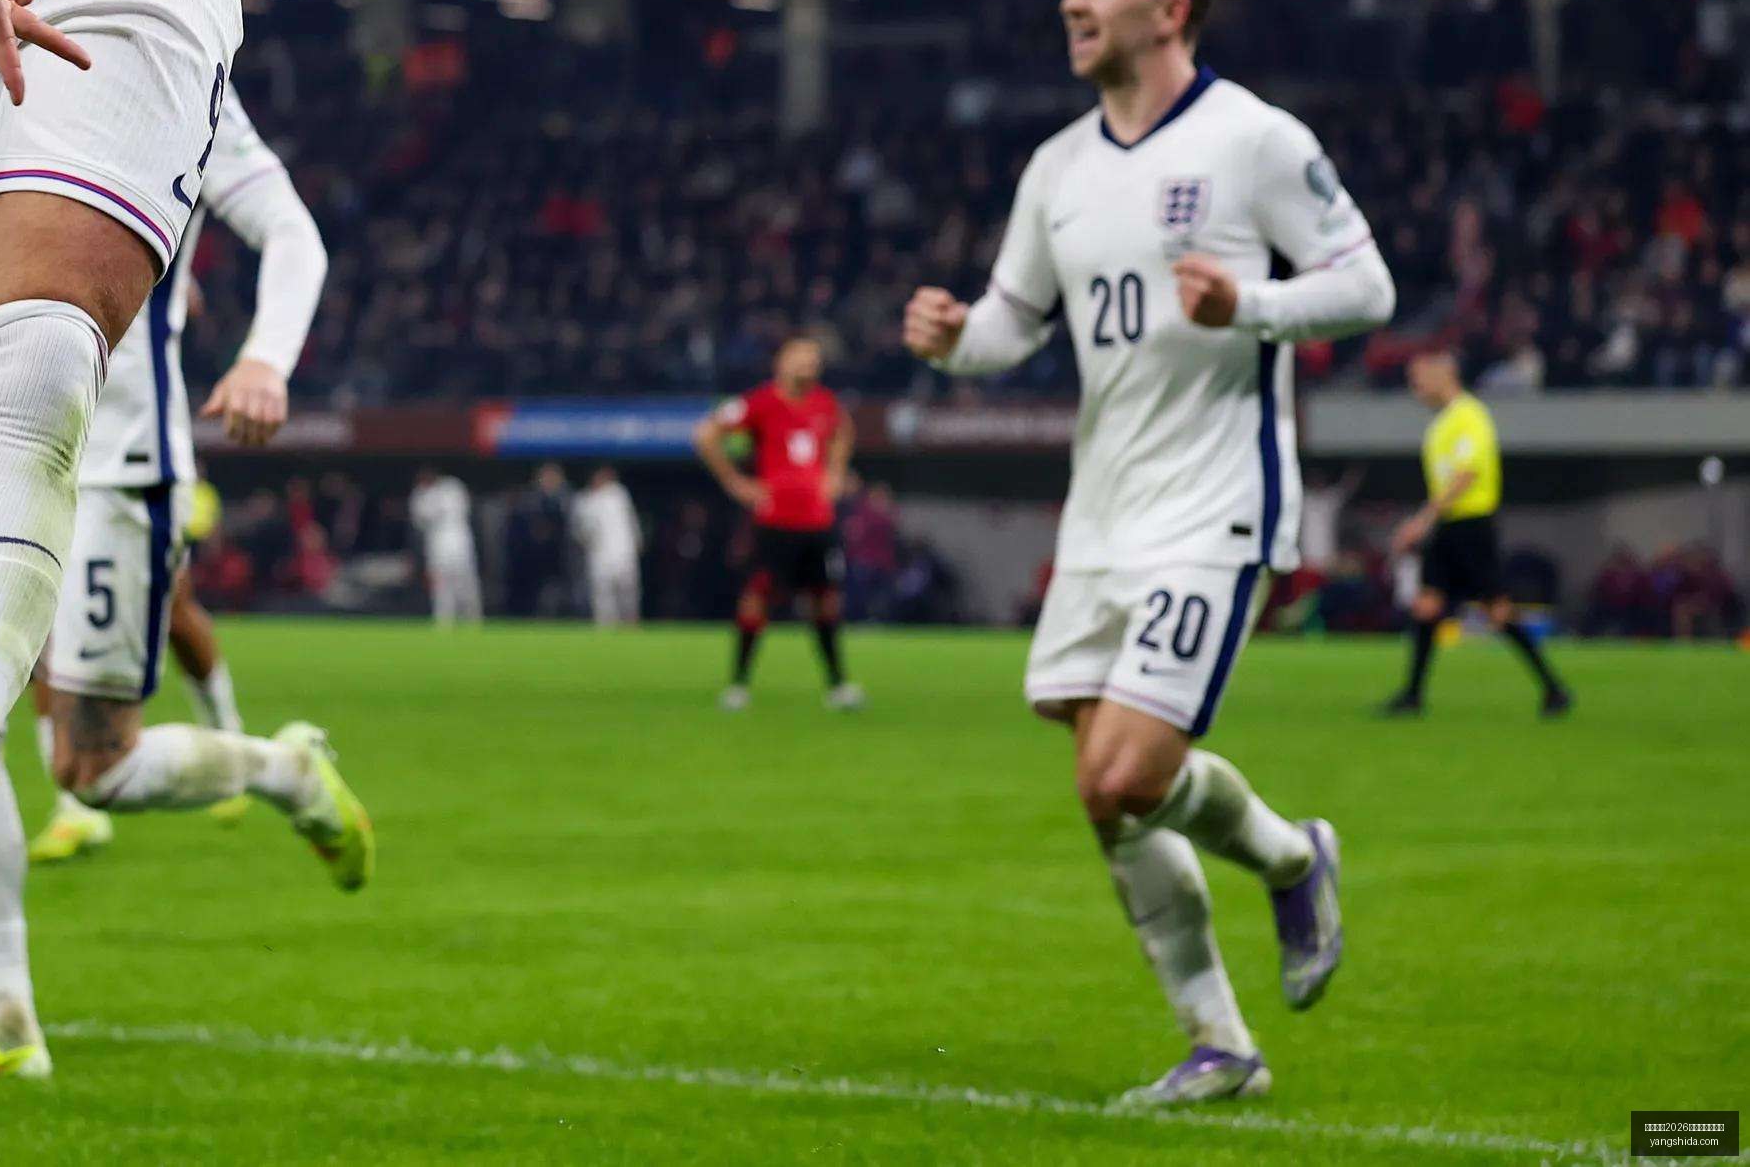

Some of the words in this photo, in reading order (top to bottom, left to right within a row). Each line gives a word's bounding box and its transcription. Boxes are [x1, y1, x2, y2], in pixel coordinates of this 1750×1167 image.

[1089, 270, 1145, 346] 20
[86, 559, 116, 631] 5
[1136, 589, 1210, 661] 20
